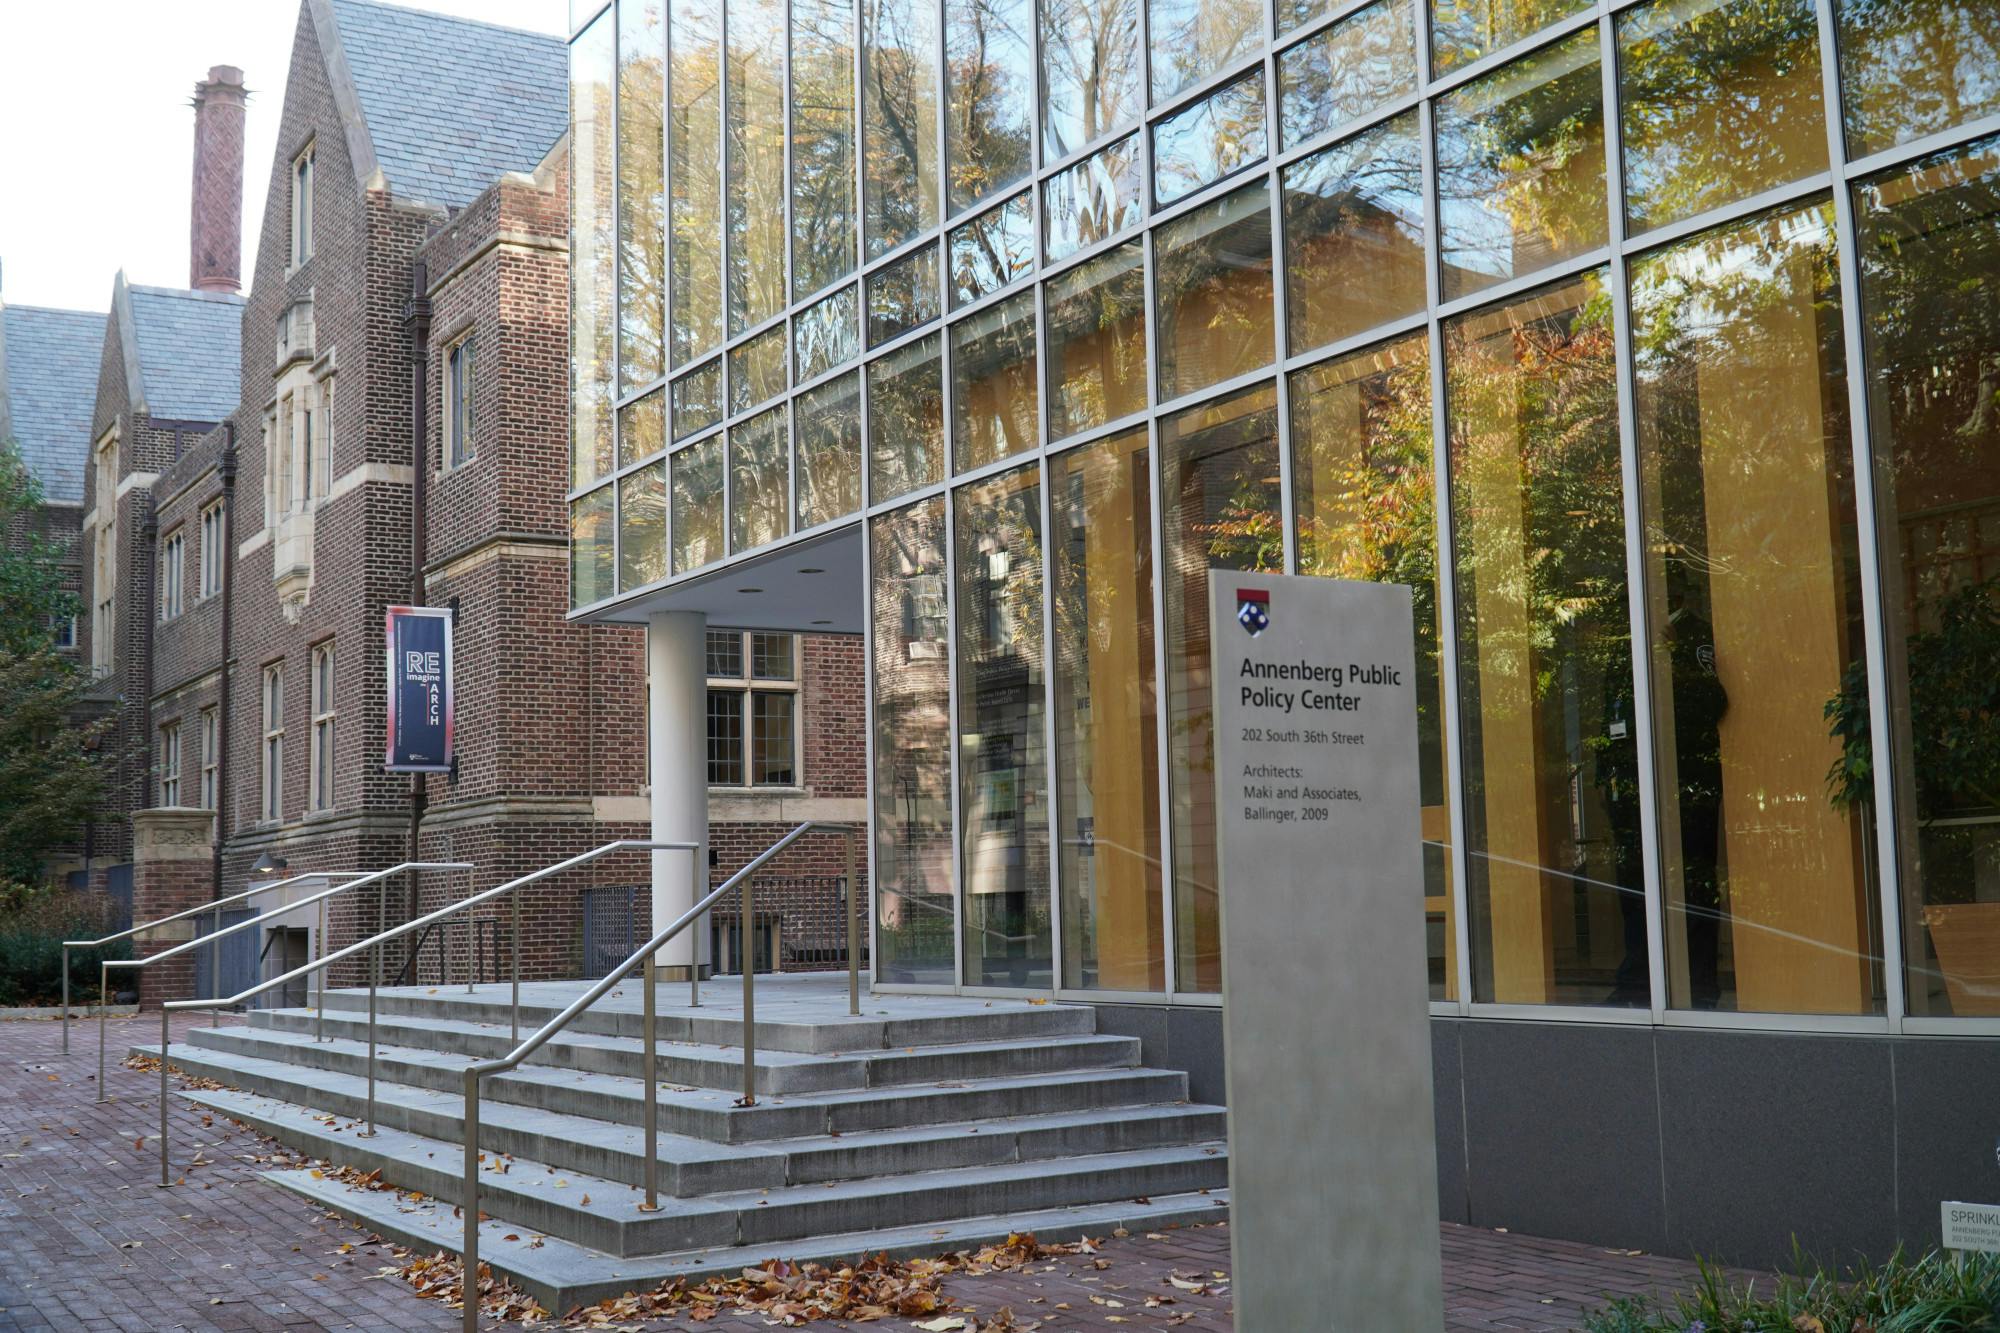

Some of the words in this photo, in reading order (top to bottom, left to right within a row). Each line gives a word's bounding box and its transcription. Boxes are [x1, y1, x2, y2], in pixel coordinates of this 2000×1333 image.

[406, 651, 440, 673] RE
[406, 673, 440, 682] imagine
[1240, 658, 1342, 687] Annenberg
[1350, 664, 1400, 686] Public
[1241, 687, 1294, 713] Policy
[1301, 690, 1360, 711] Center
[1241, 728, 1262, 742] 202
[1266, 729, 1299, 743] South
[1303, 730, 1328, 744] 36th
[1332, 731, 1364, 745] Street
[1243, 764, 1303, 778] Architects:
[1244, 786, 1272, 799] Maki
[1277, 786, 1298, 799] and
[1302, 787, 1362, 802] Associates,
[1244, 807, 1297, 823] Ballinger,
[1301, 808, 1328, 821] 2009
[1951, 1210, 2000, 1226] SPRINKL
